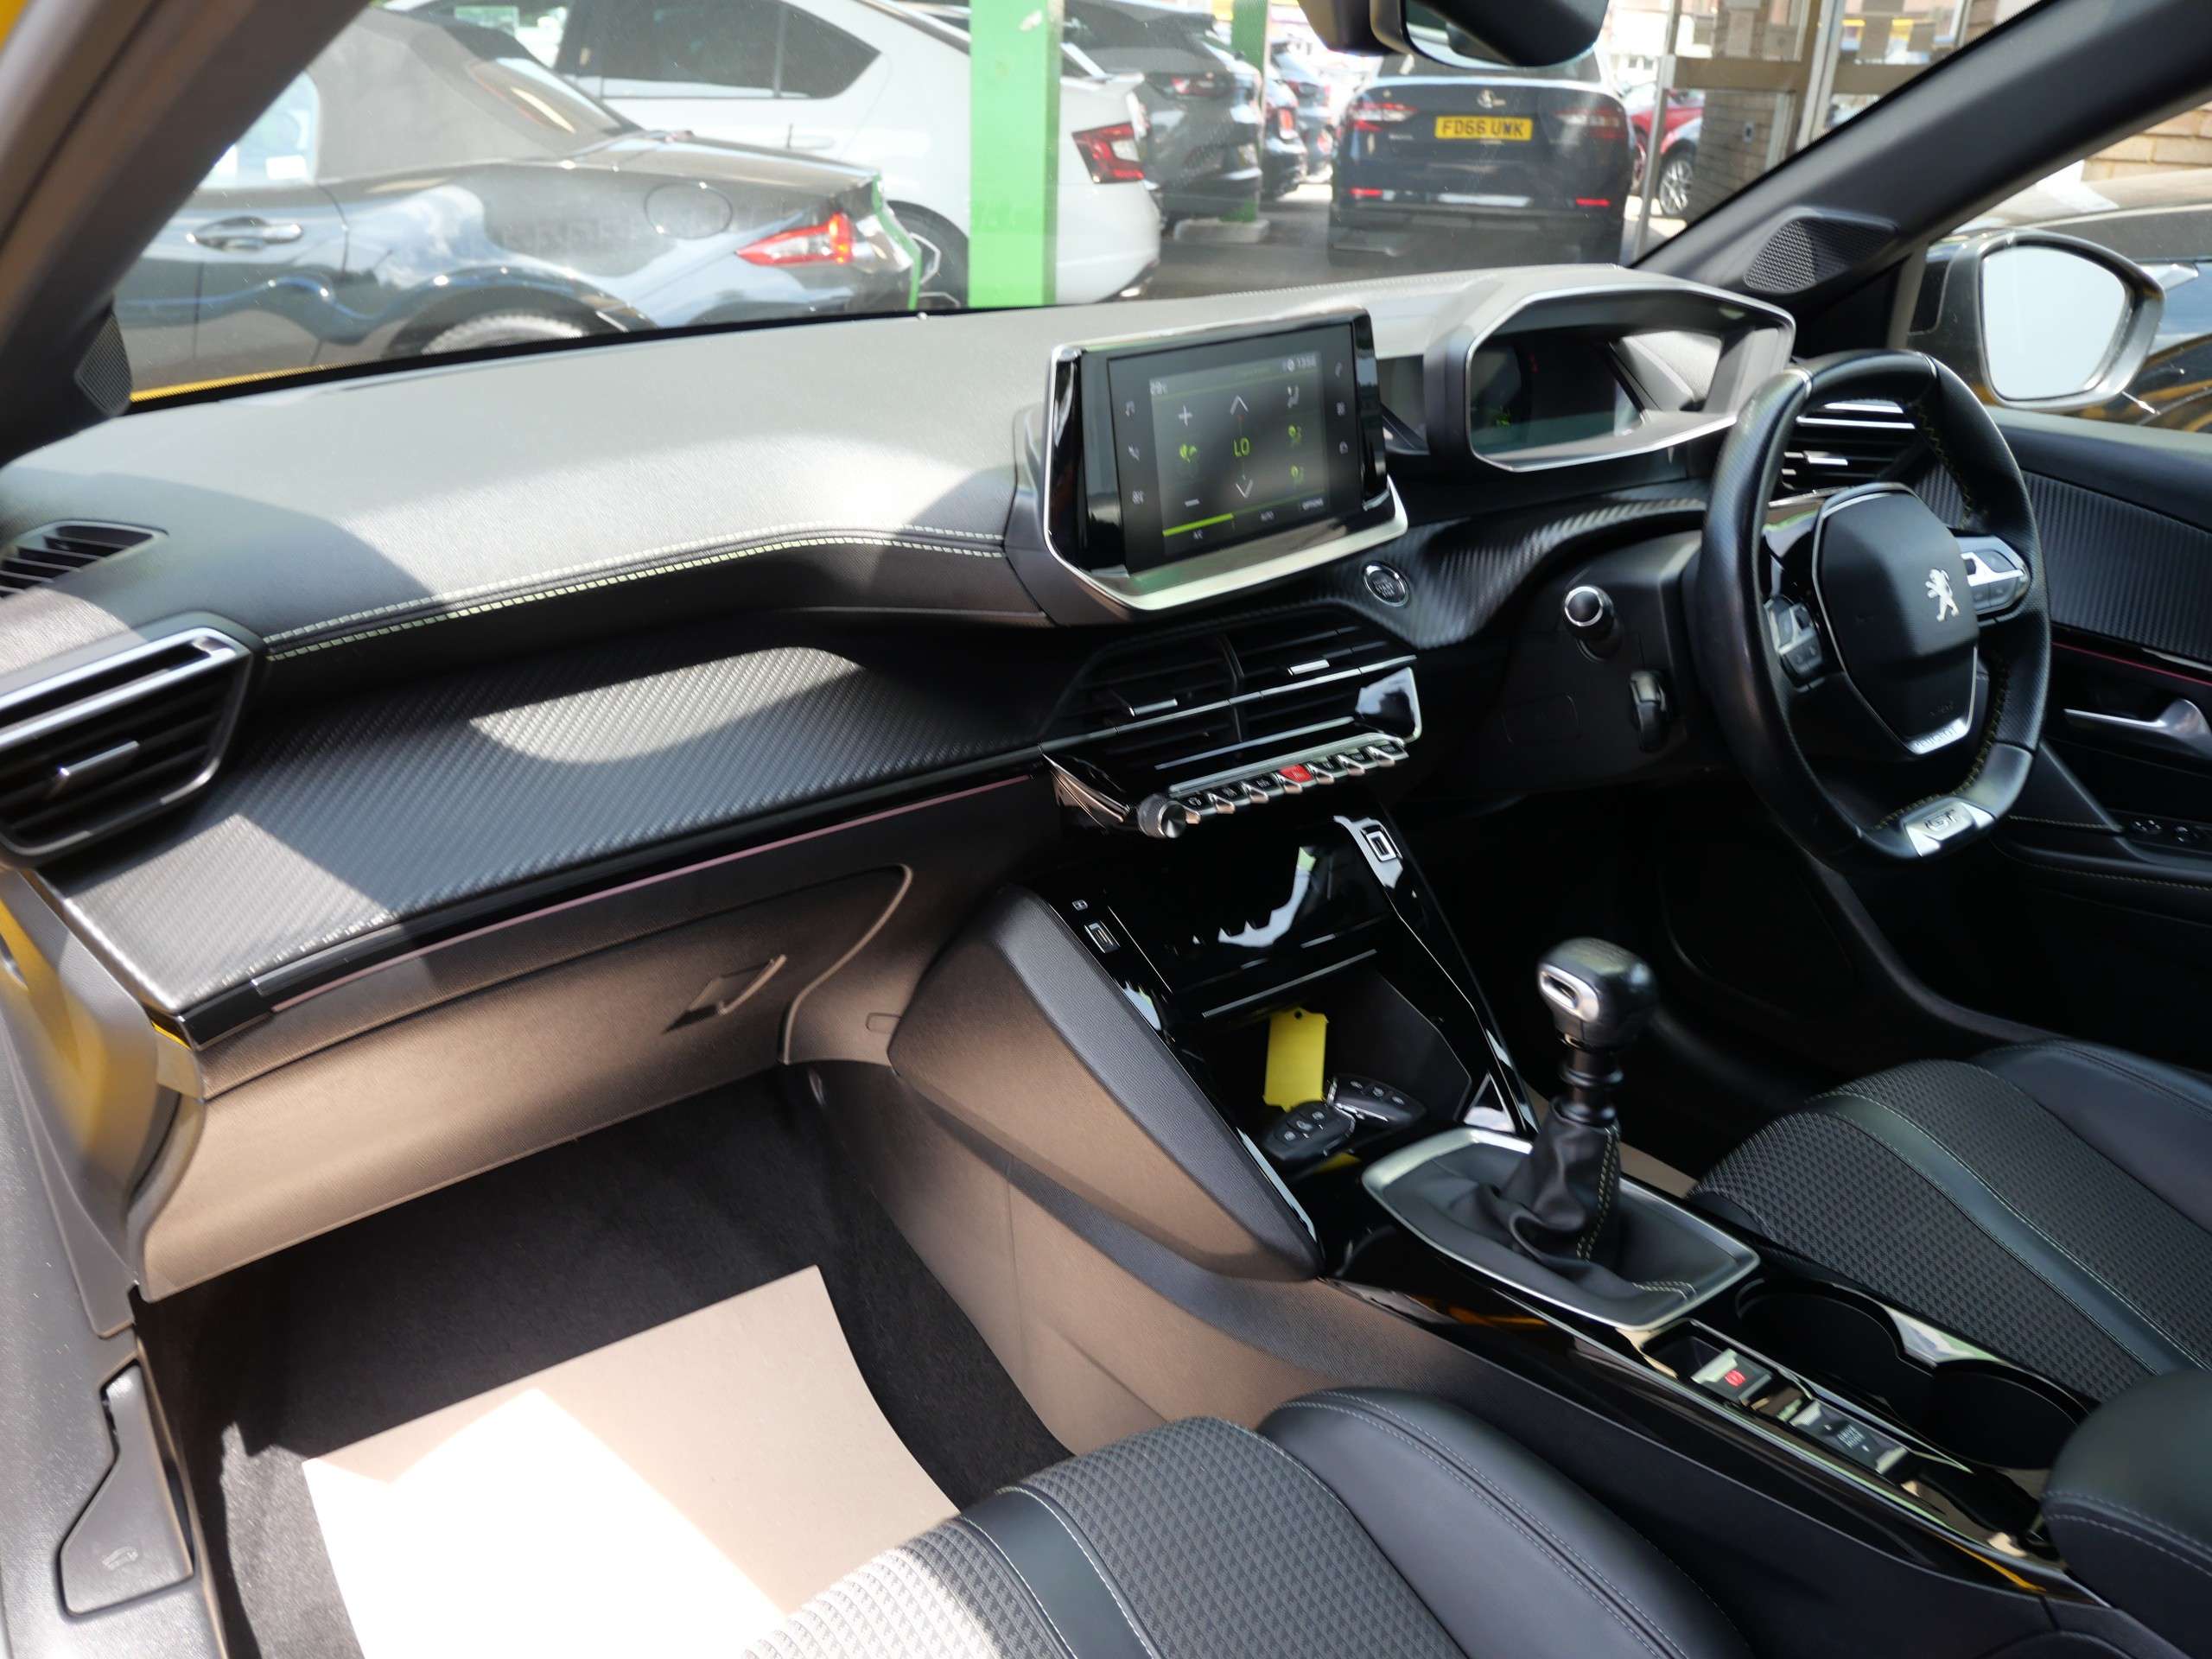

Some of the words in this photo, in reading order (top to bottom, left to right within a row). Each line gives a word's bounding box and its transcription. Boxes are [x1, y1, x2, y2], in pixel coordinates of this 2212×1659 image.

[1441, 118, 1485, 135] FD66
[1491, 120, 1524, 137] UWK
[1233, 437, 1250, 456] LO
